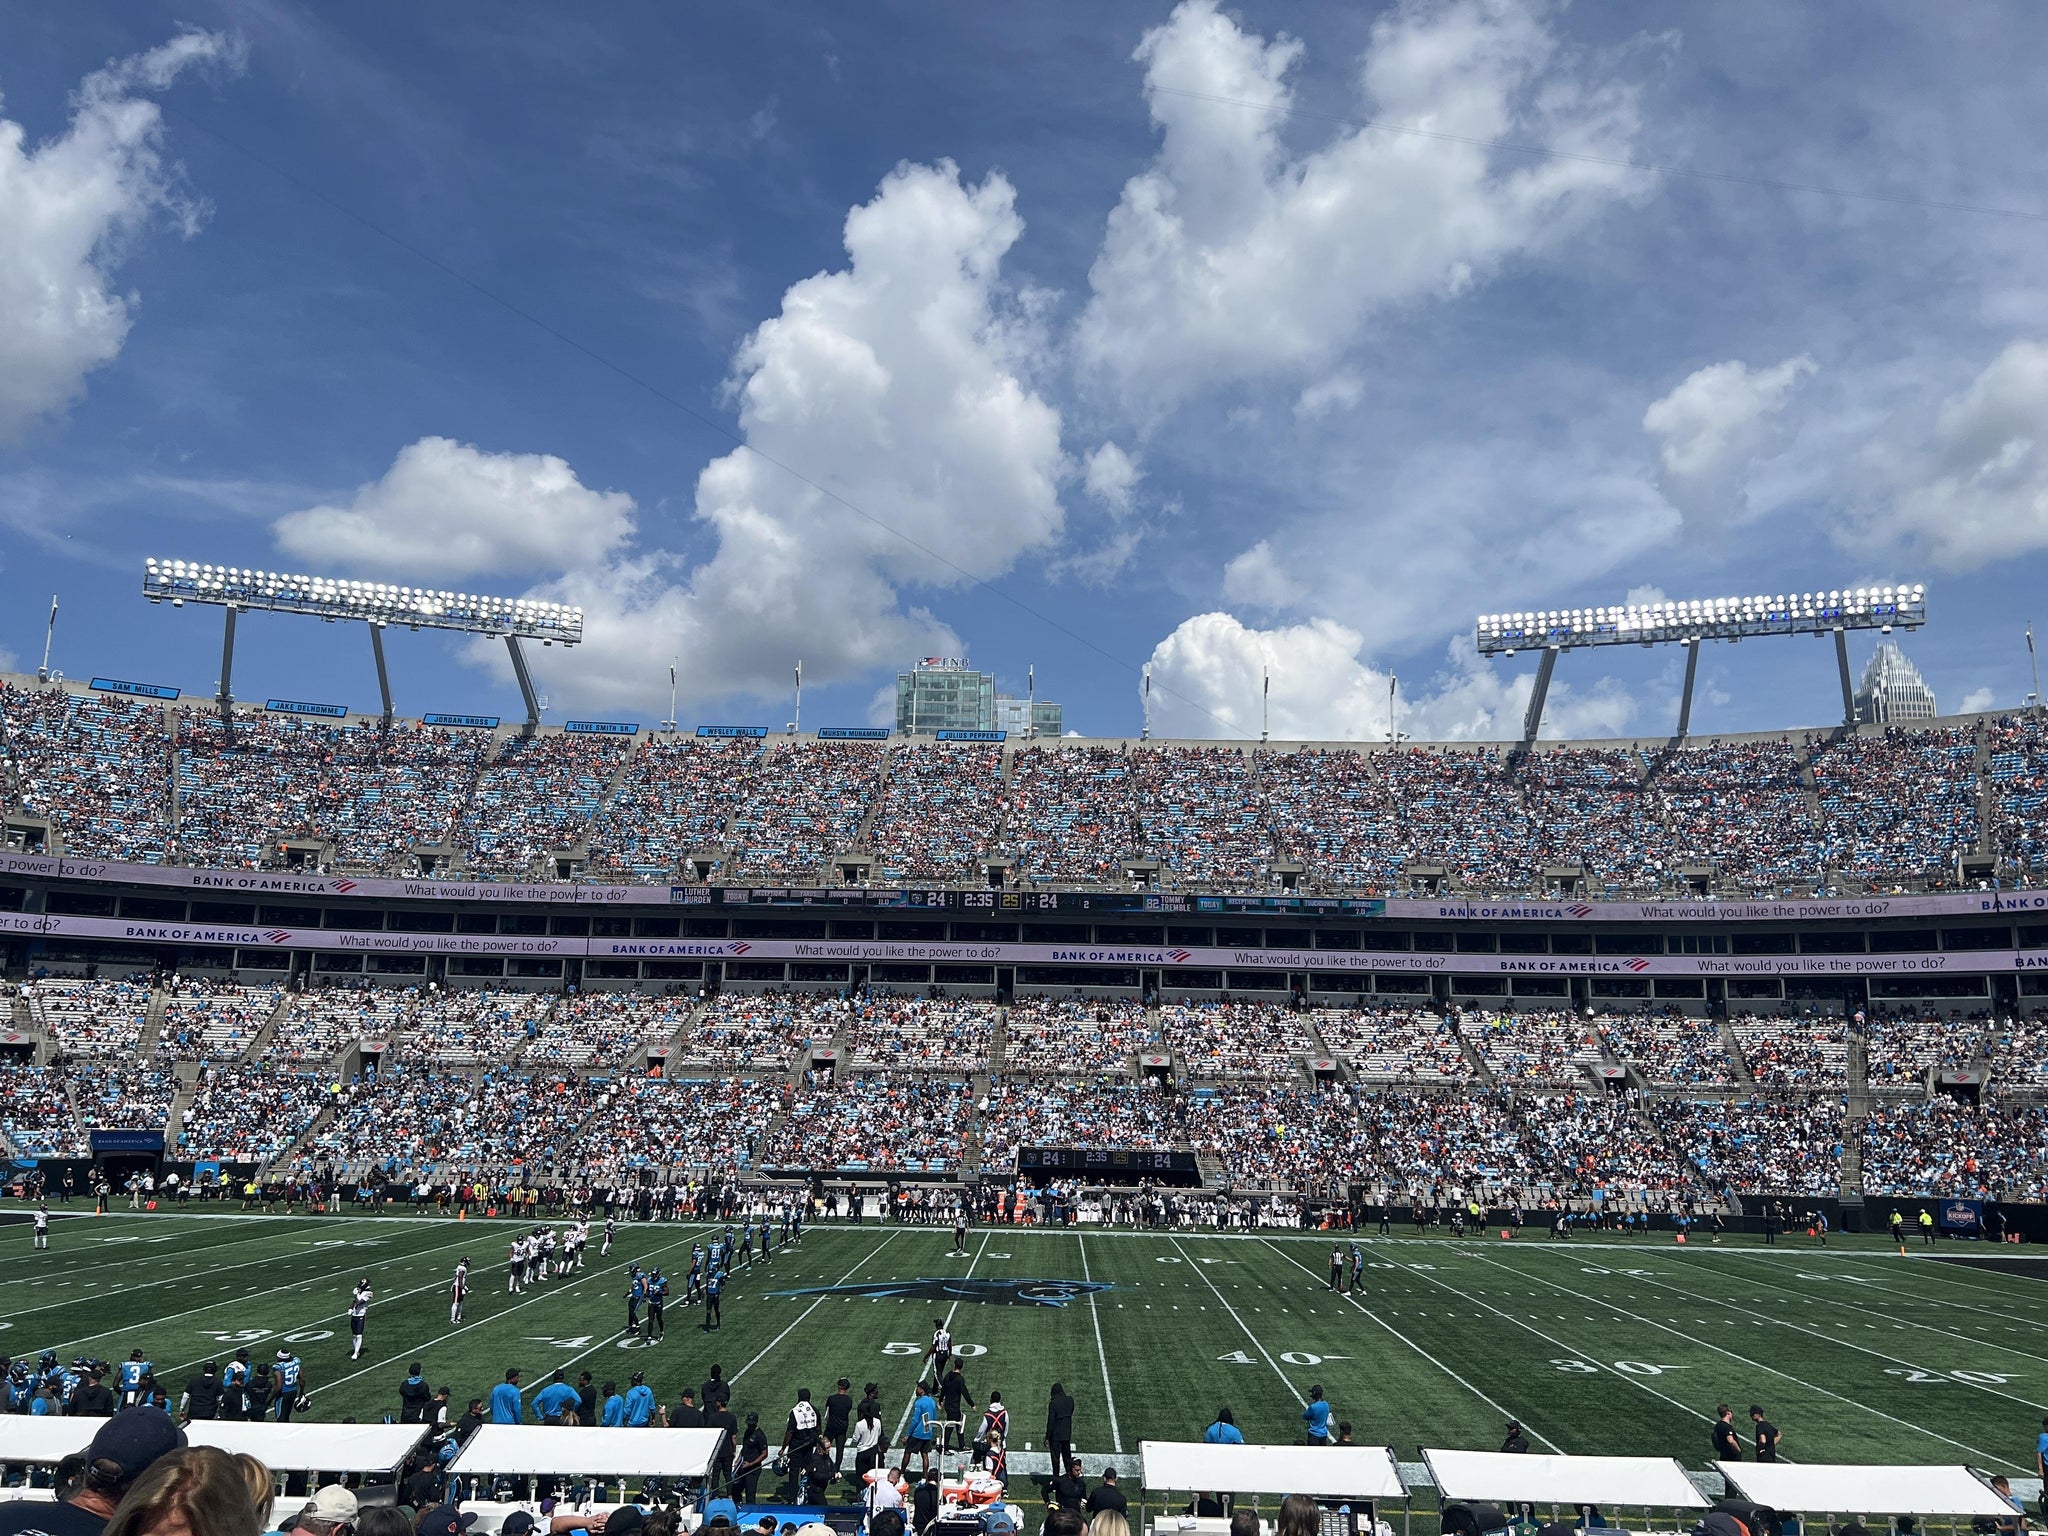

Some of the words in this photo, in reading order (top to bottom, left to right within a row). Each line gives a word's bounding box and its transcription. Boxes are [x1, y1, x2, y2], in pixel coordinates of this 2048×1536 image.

[112, 682, 131, 692] SAM
[134, 686, 159, 695] MILLS
[275, 702, 295, 710] JAKE
[297, 704, 339, 714] DELHOMME
[434, 716, 462, 724] JORDAN
[465, 718, 489, 726] GROSS
[596, 724, 617, 732] SMITH
[848, 730, 886, 738] MUHAMMAD
[969, 732, 999, 740] PEPPERS
[8, 860, 54, 875] power
[59, 862, 75, 875] to
[79, 863, 106, 877] do?
[193, 876, 234, 887] BANK
[238, 878, 258, 888] OF
[260, 880, 326, 892] AMERICA
[404, 884, 436, 896] What
[440, 884, 476, 898] would
[478, 888, 500, 902] you
[502, 887, 523, 899] like
[526, 888, 546, 900] the
[550, 890, 589, 904] power
[592, 890, 603, 900] to
[606, 890, 628, 901] do?
[672, 890, 684, 900] 10
[684, 888, 710, 896] LUTHER
[685, 896, 711, 904] BURDEN
[927, 892, 946, 906] 24
[964, 894, 994, 906] 2:35
[1002, 894, 1019, 907] 25
[1040, 894, 1057, 908] 24
[1084, 900, 1090, 909] 2
[1147, 899, 1159, 908] 82
[1160, 896, 1185, 904] TOMMY
[1982, 899, 2028, 910] BANK
[2034, 898, 2048, 907] O
[1161, 904, 1191, 912] TREMBLE
[1440, 907, 1477, 918] BANK
[1482, 908, 1498, 918] OF
[1501, 908, 1562, 918] AMERICA
[1641, 906, 1674, 918] What
[1678, 906, 1714, 918] would
[1719, 909, 1743, 920] you
[1746, 906, 1768, 918] like
[1774, 906, 1794, 917] the
[1800, 907, 1842, 919] power
[1846, 905, 1860, 916] to
[1865, 902, 1890, 914] do?
[14, 918, 28, 930] to
[33, 918, 61, 932] do?
[126, 927, 167, 938] BANK
[172, 929, 191, 939] OF
[194, 931, 260, 943] AMERICA
[340, 934, 370, 948] What
[374, 935, 409, 948] would
[412, 939, 434, 951] you
[437, 938, 458, 950] like
[460, 938, 480, 950] the
[482, 942, 520, 953] power
[522, 941, 534, 951] to
[537, 940, 558, 952] do?
[612, 944, 646, 954] BANK
[650, 945, 666, 954] OF
[668, 946, 724, 954] AMERICA
[794, 944, 824, 956] What
[826, 945, 860, 957] would
[861, 948, 882, 959] you
[885, 946, 904, 957] like
[907, 946, 926, 958] the
[928, 948, 964, 960] power
[966, 948, 978, 958] to
[980, 946, 1001, 958] do?
[1052, 951, 1086, 960] BANK
[1089, 952, 1104, 961] OF
[1107, 952, 1164, 962] AMERICA
[1234, 952, 1264, 964] What
[1266, 952, 1300, 965] would
[1303, 956, 1324, 968] you
[1327, 955, 1346, 966] like
[1350, 956, 1368, 967] the
[1372, 958, 1406, 970] power
[1410, 958, 1422, 968] to
[1426, 956, 1446, 968] do?
[1500, 961, 1536, 971] BANK
[1539, 962, 1556, 971] OF
[1558, 962, 1620, 972] AMERICA
[1697, 960, 1730, 972] What
[1738, 960, 1772, 972] would
[1776, 962, 1798, 974] you
[1803, 960, 1824, 971] like
[1830, 959, 1852, 970] the
[1856, 961, 1896, 973] power
[1902, 959, 1916, 970] to
[1921, 957, 1946, 969] do?
[1042, 1152, 1059, 1165] 24
[1086, 1152, 1107, 1162] 2:35
[1115, 1153, 1127, 1162] 25
[1154, 1154, 1171, 1168] 24
[711, 1249, 720, 1258] 81
[129, 1366, 140, 1384] 3
[285, 1365, 299, 1385] 52
